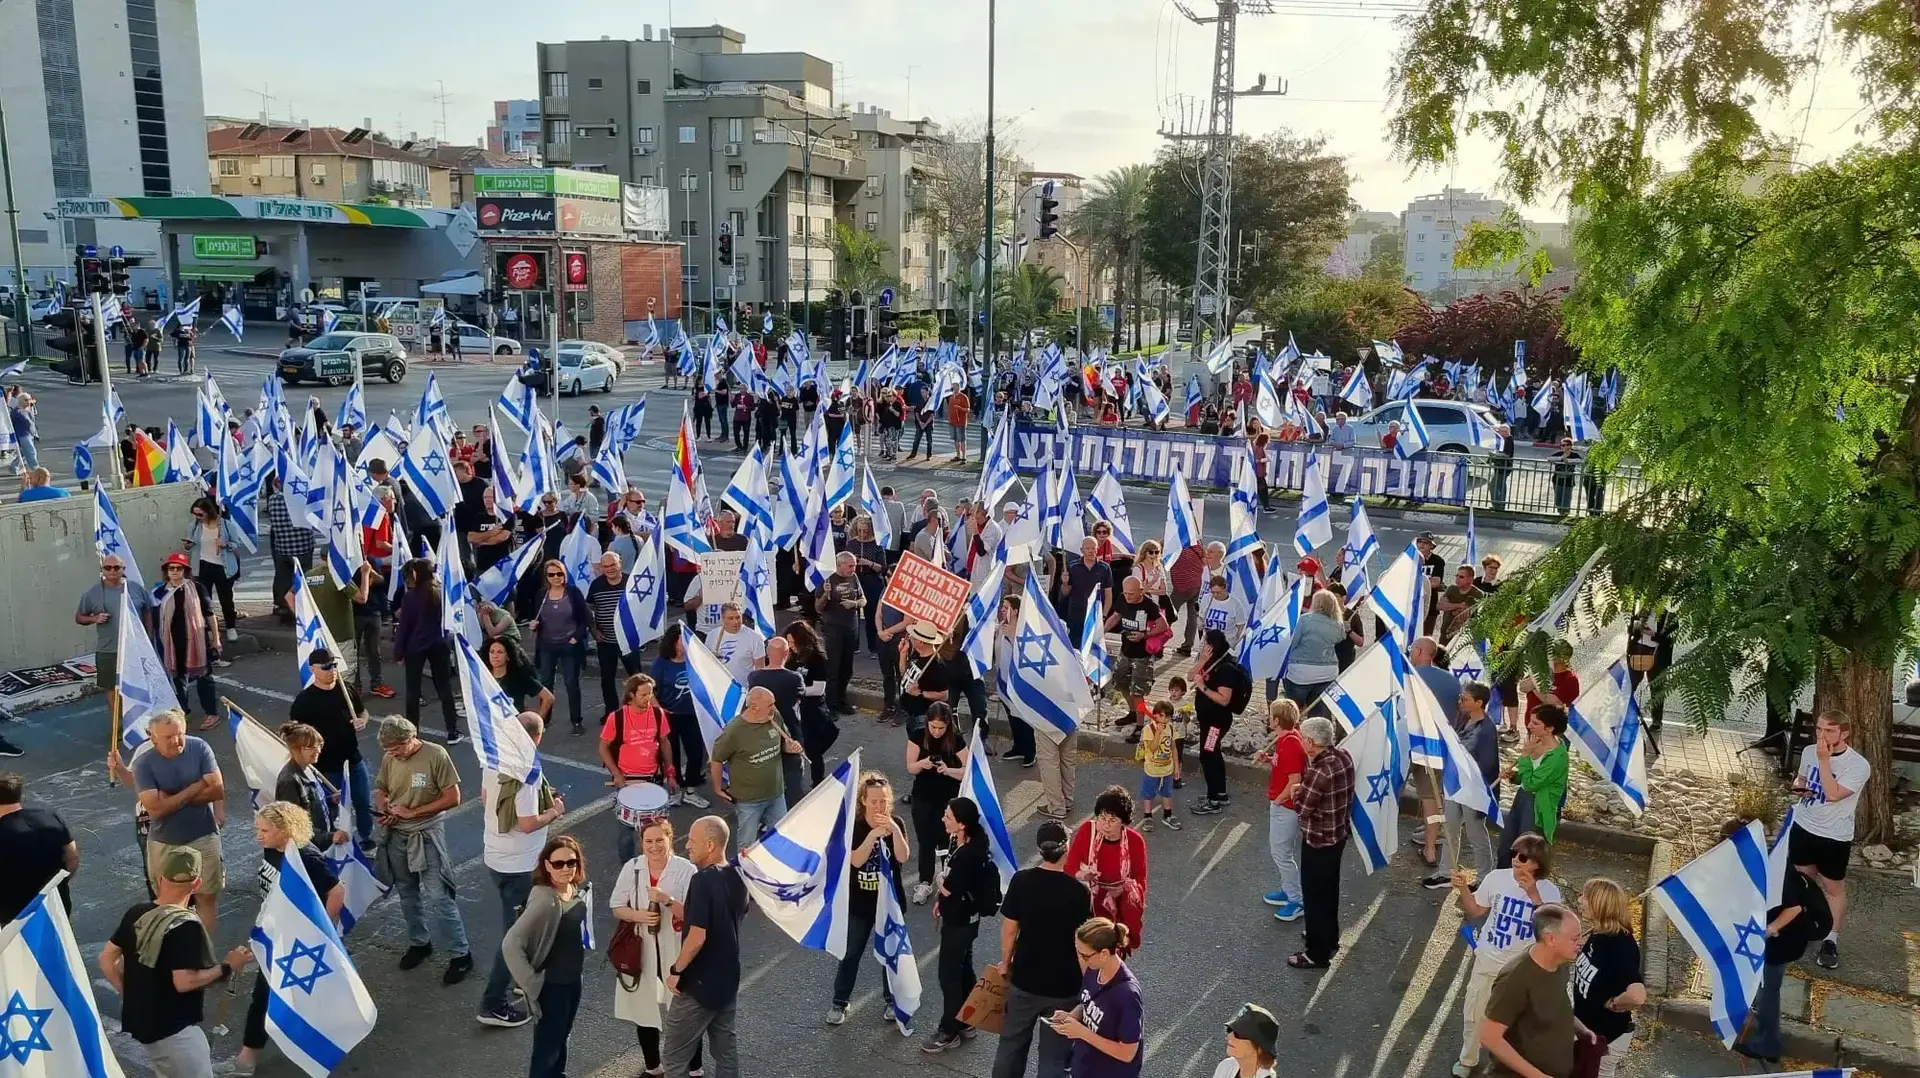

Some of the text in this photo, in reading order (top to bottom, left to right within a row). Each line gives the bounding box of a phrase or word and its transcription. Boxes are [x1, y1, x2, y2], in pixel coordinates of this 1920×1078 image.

[498, 178, 529, 188] אלונית
[258, 200, 334, 218] דור אלון
[501, 208, 553, 222] Pizza Hut
[578, 209, 602, 228] Pizza
[602, 212, 621, 227] Hut
[208, 240, 237, 252] אלונית
[1079, 434, 1216, 480] להחרבת
[1361, 457, 1457, 498] חובה
[898, 572, 912, 589] חיי
[902, 557, 966, 598] הרופאות
[911, 578, 924, 595] על
[888, 587, 951, 627] הדמוקרטיה
[1208, 609, 1228, 621] דמו
[1501, 896, 1535, 921] דמו
[1496, 914, 1534, 940] קרט
[1495, 930, 1512, 949] יה
